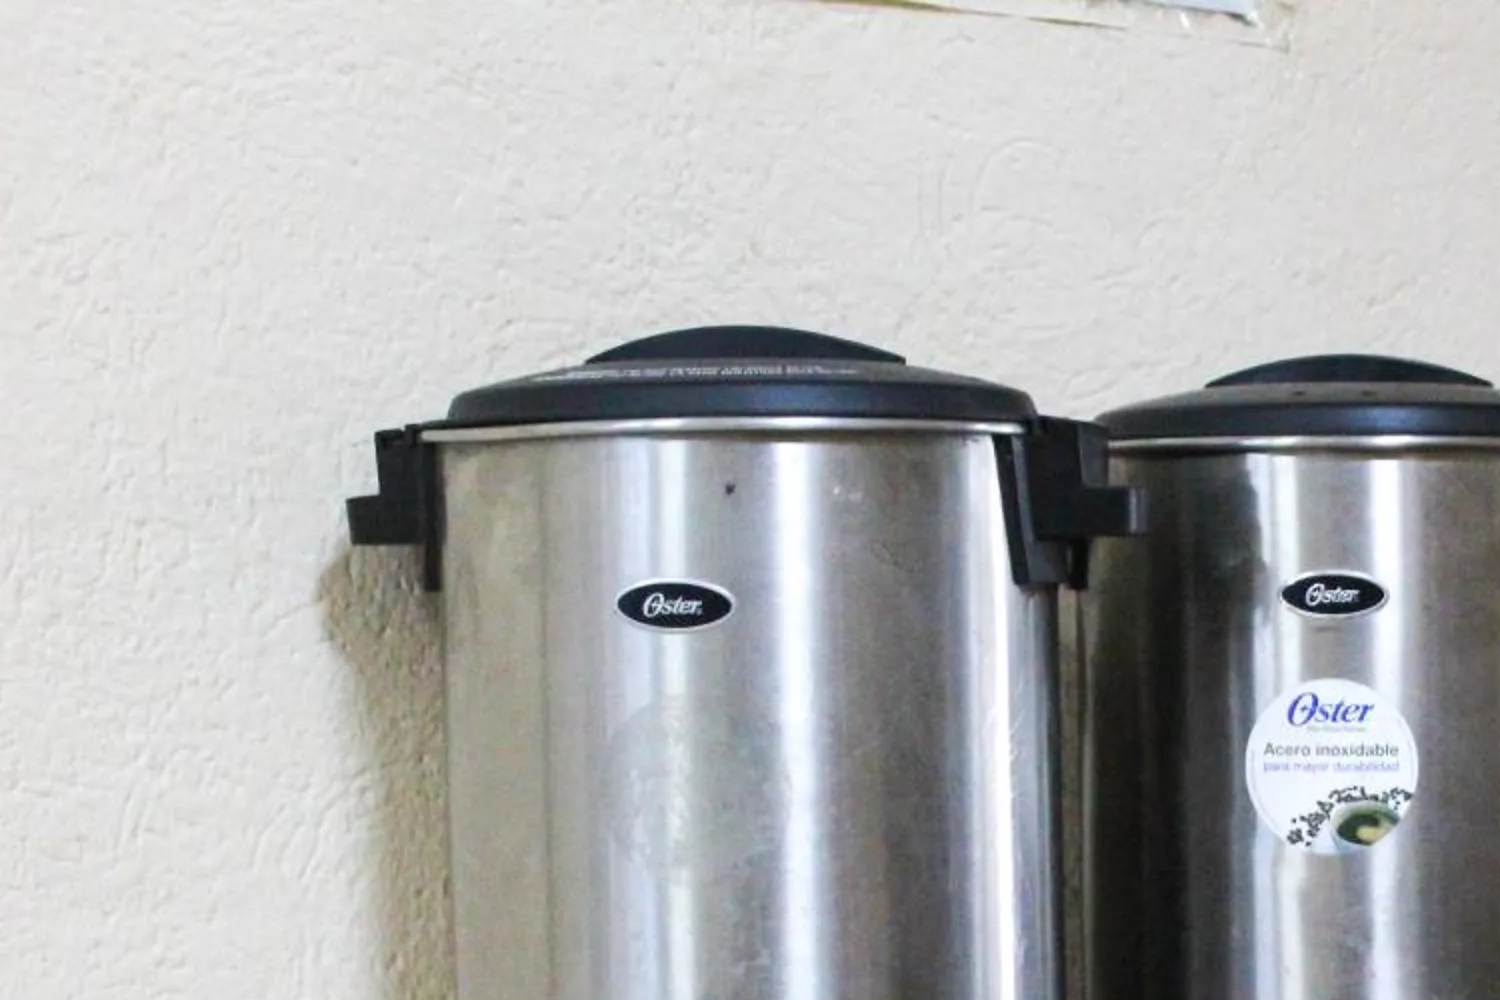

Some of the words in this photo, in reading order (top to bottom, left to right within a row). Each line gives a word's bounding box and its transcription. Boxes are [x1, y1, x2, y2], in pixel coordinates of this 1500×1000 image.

[642, 592, 703, 618] Oster
[1306, 583, 1361, 607] Oster
[1287, 692, 1374, 726] Oster
[1263, 742, 1311, 757] Acero
[1315, 742, 1399, 757] inoxidable
